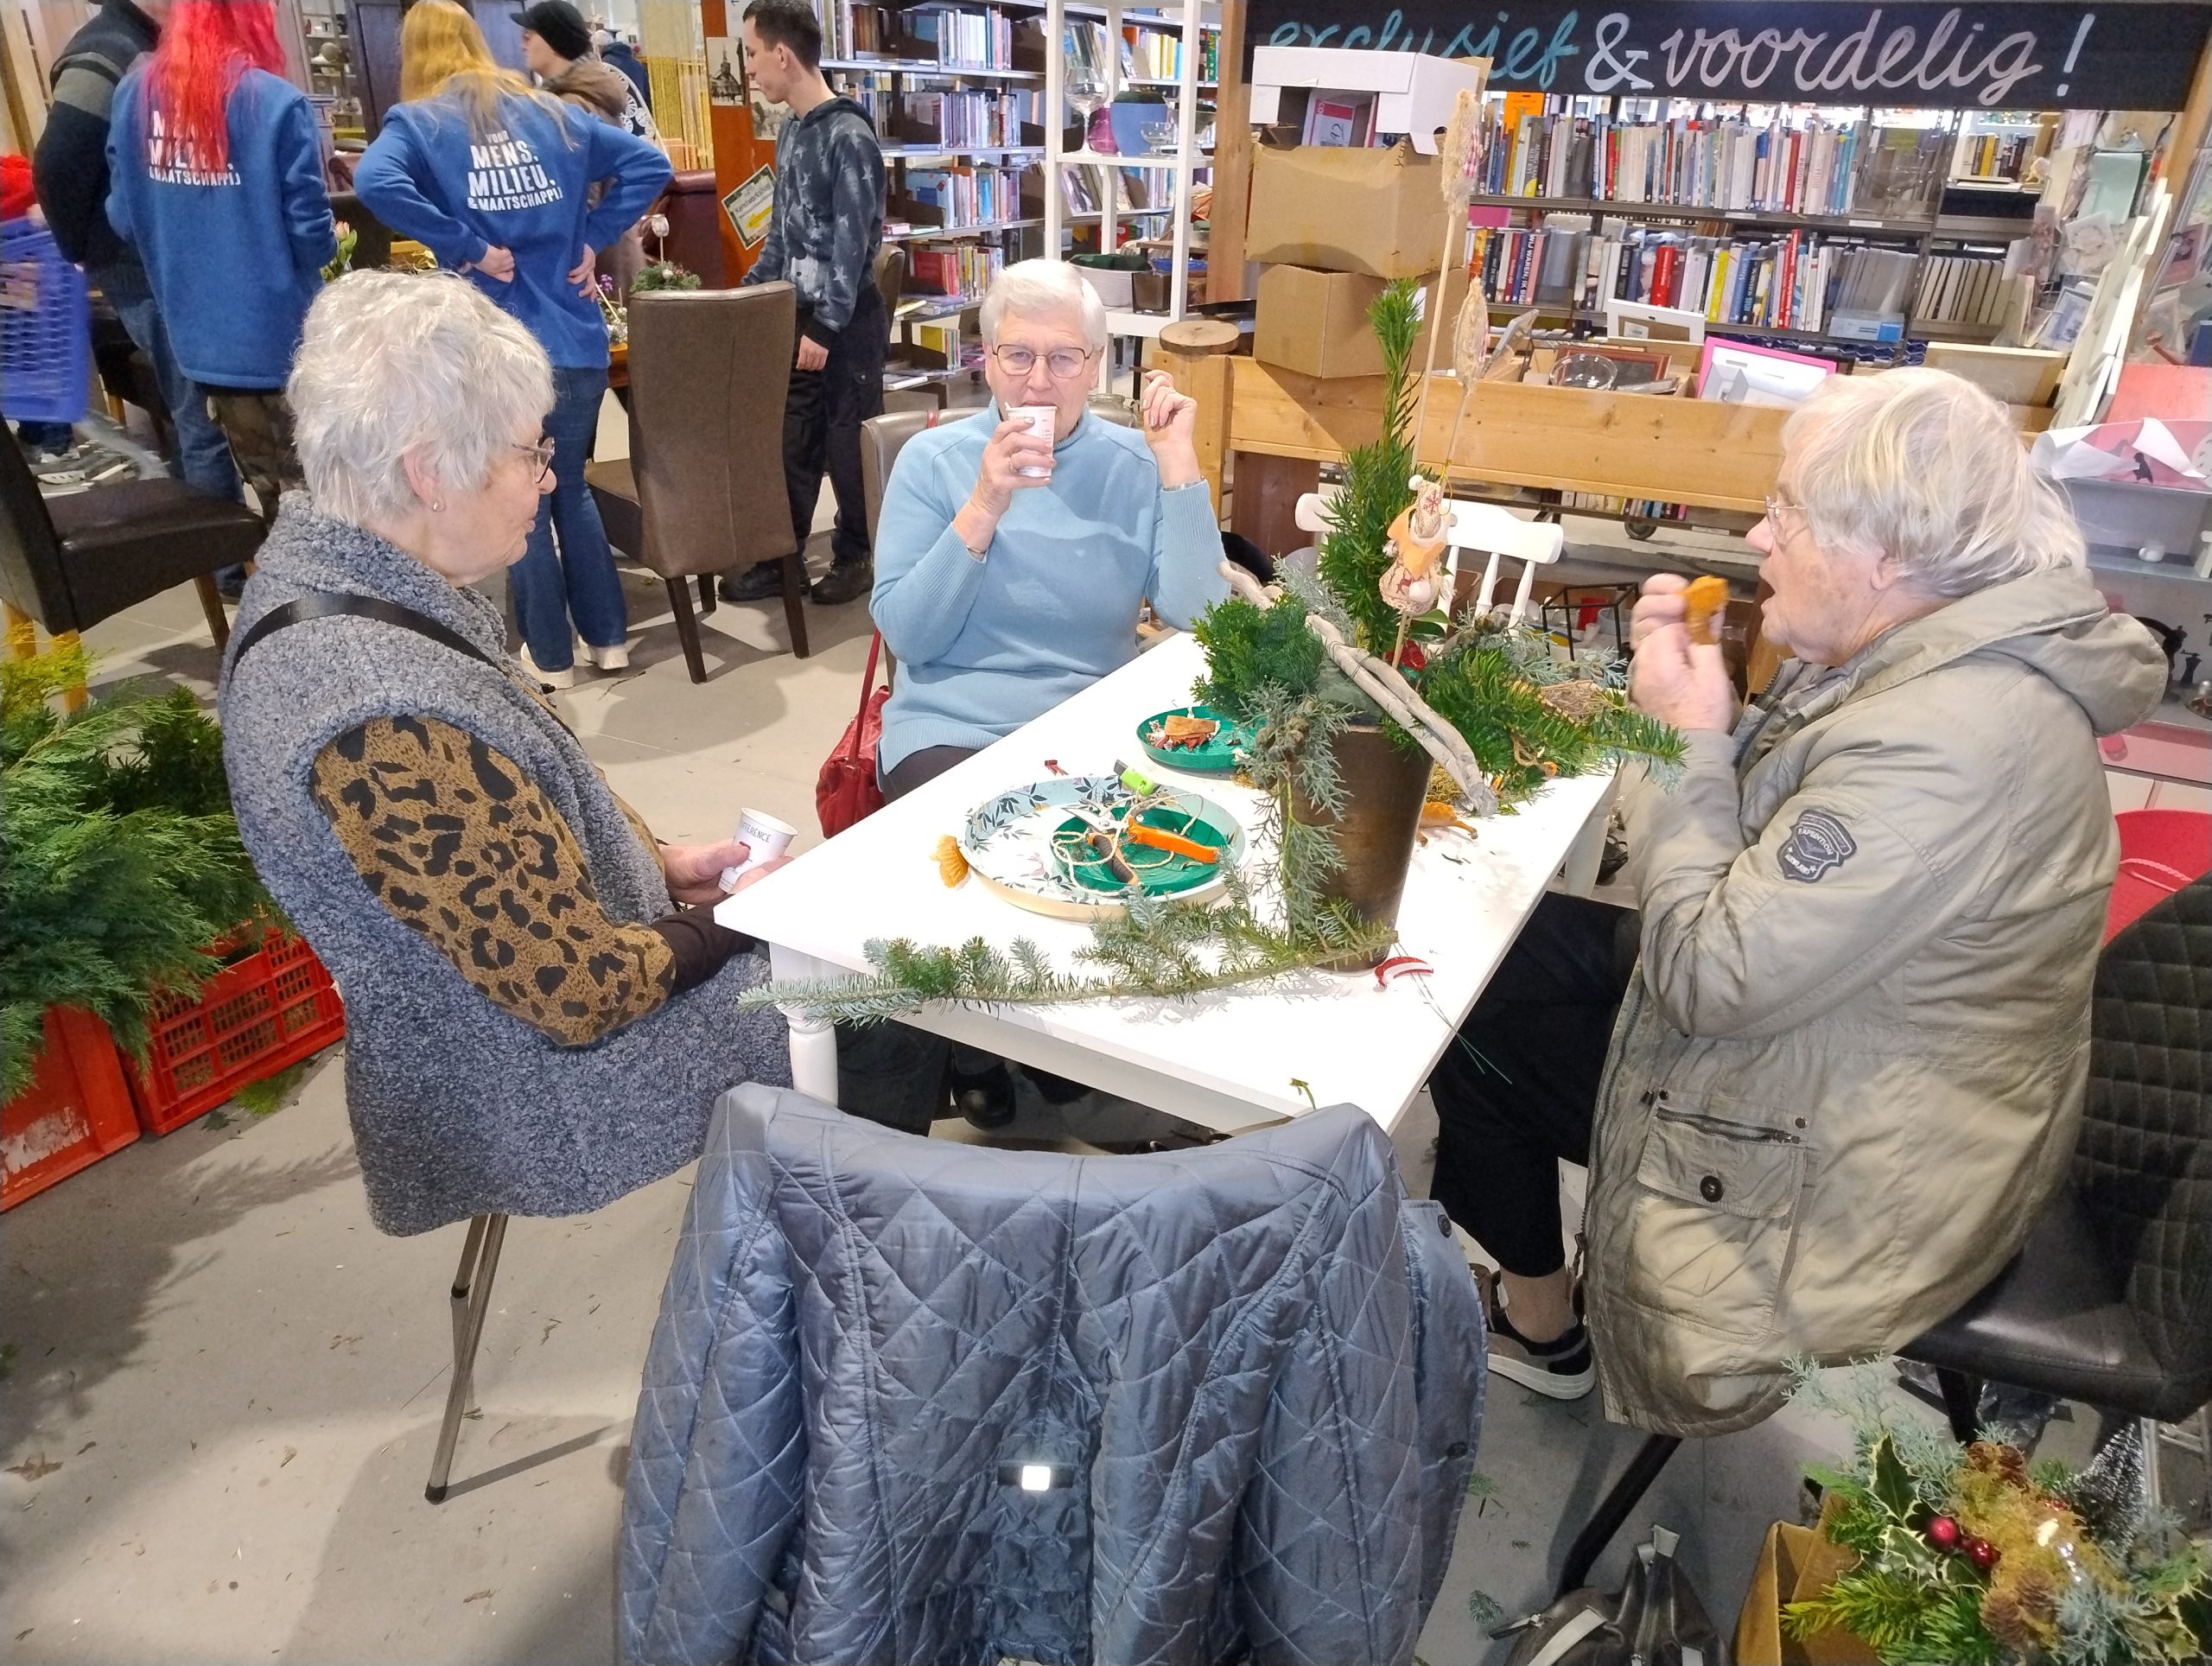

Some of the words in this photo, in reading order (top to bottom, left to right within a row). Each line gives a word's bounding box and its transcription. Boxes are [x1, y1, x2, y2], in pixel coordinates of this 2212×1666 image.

[1584, 12, 1655, 92] &
[469, 140, 539, 169] MENS.
[467, 164, 556, 197] MILIEU.
[1798, 828, 1834, 855] EXPEDITION
